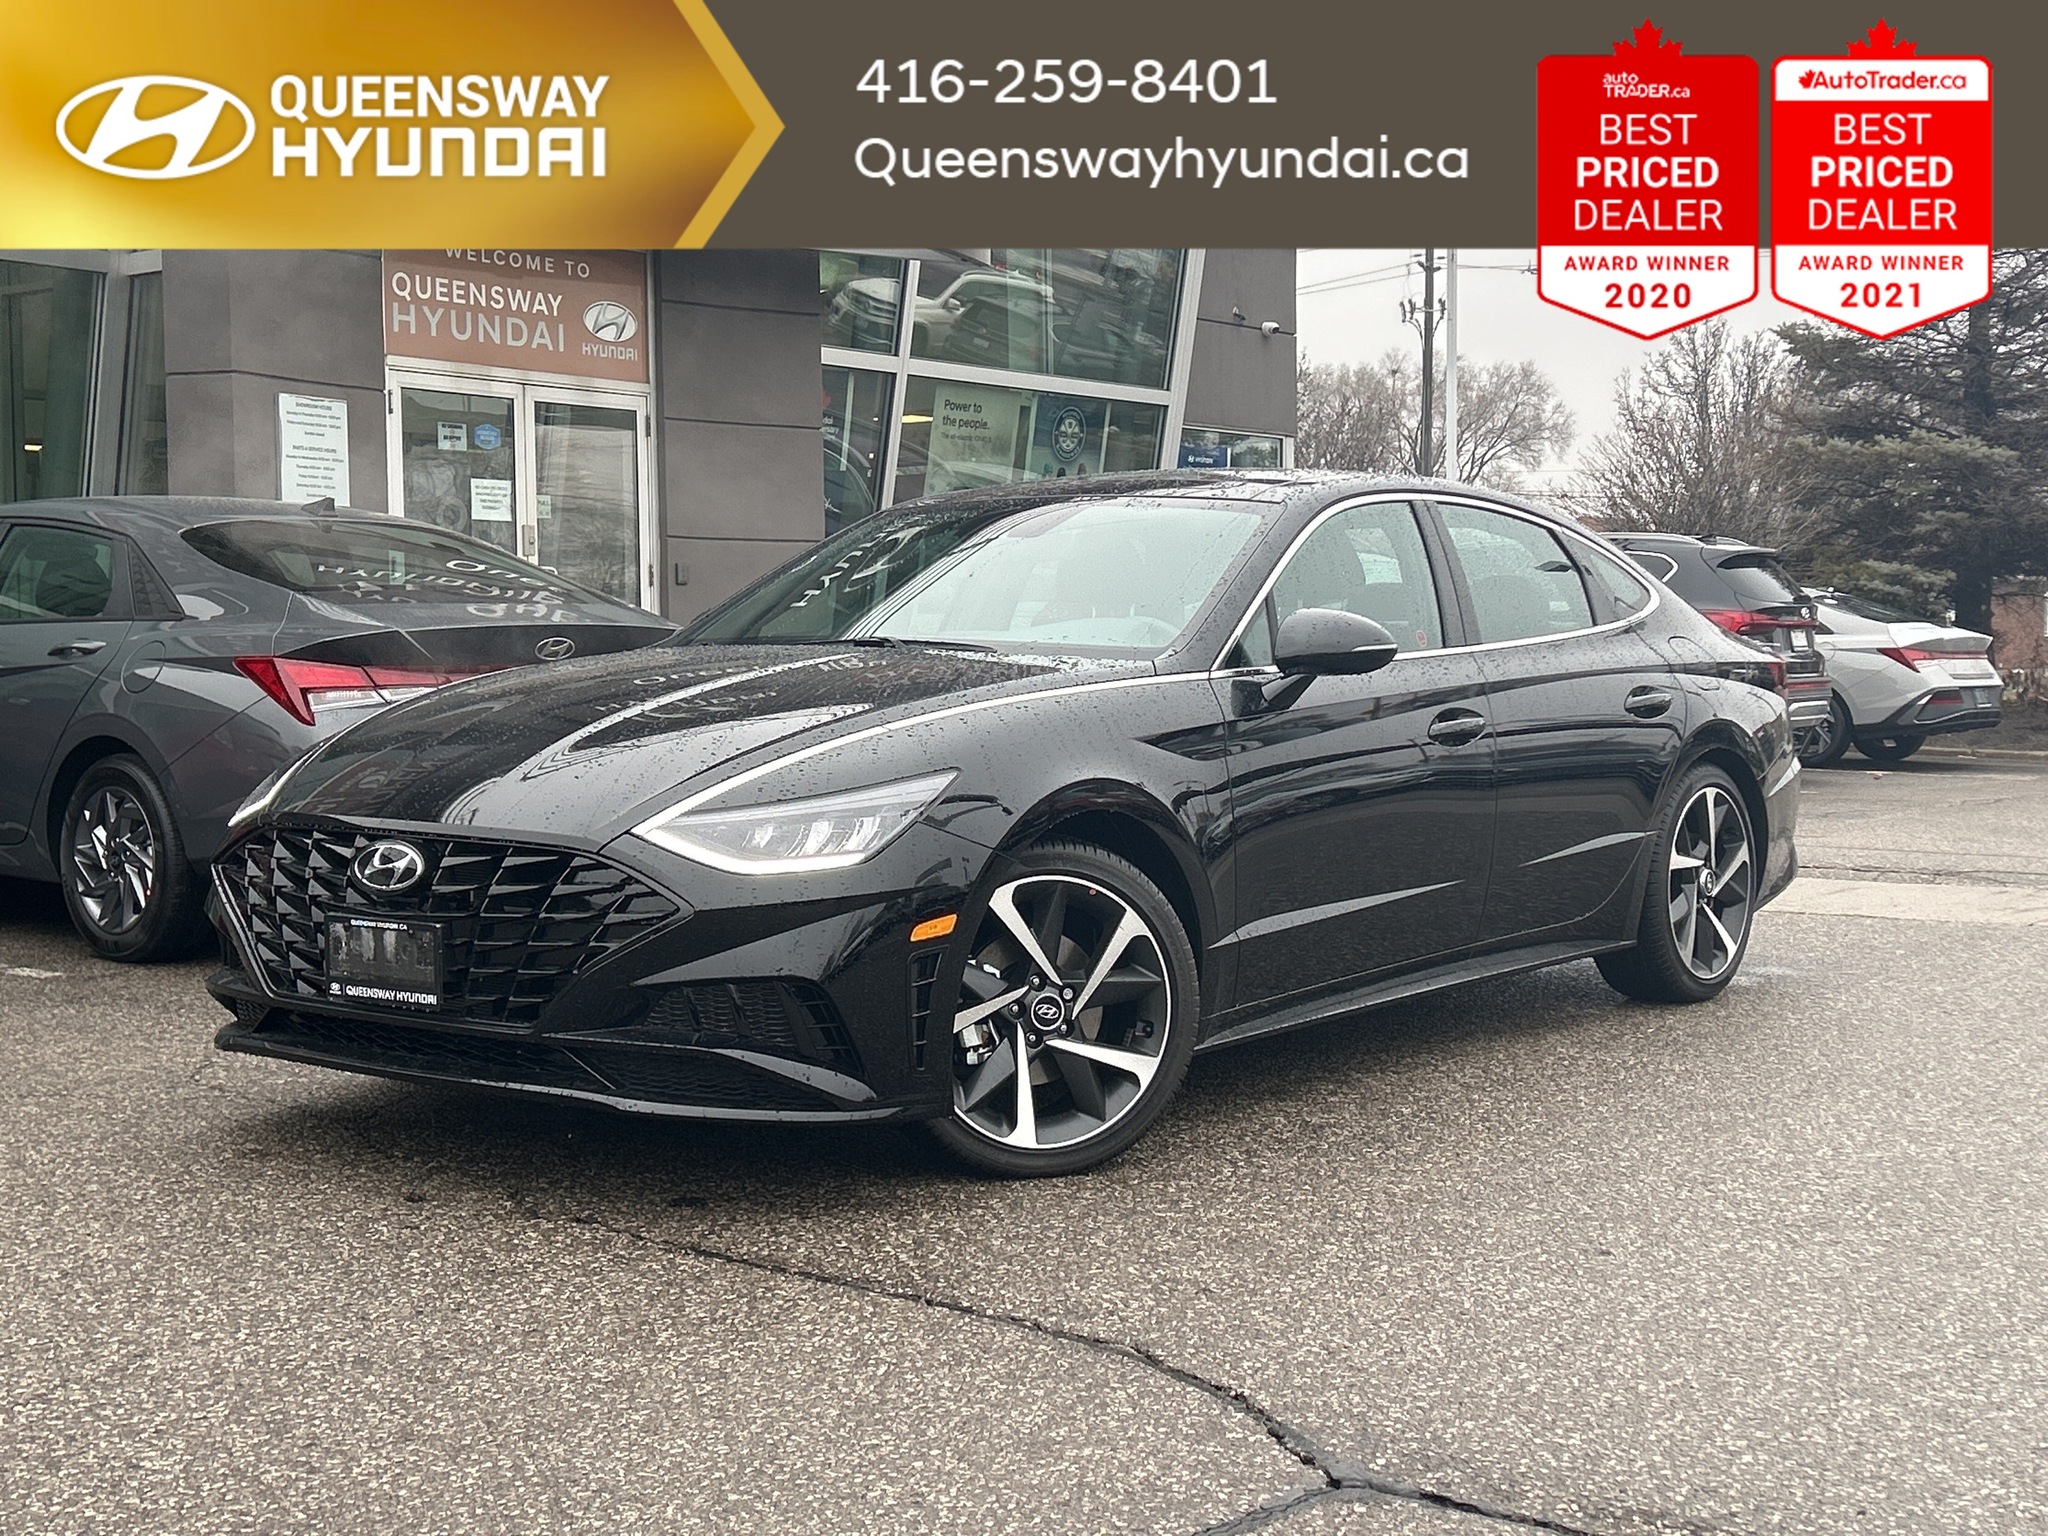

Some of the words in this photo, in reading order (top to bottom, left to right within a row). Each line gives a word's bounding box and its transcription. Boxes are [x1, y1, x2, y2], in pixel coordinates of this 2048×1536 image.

[445, 249, 555, 273] WELCOME
[564, 260, 590, 278] TO
[391, 272, 563, 317] QUEENSWAY
[392, 302, 564, 352] HYUNDAI
[582, 342, 638, 361] HYUNDAI
[944, 399, 972, 412] Power
[973, 402, 983, 413] to
[942, 415, 957, 427] the
[958, 417, 989, 431] people.
[345, 985, 396, 1001] QUEENSWAY
[396, 991, 437, 1005] HYUNDAI
